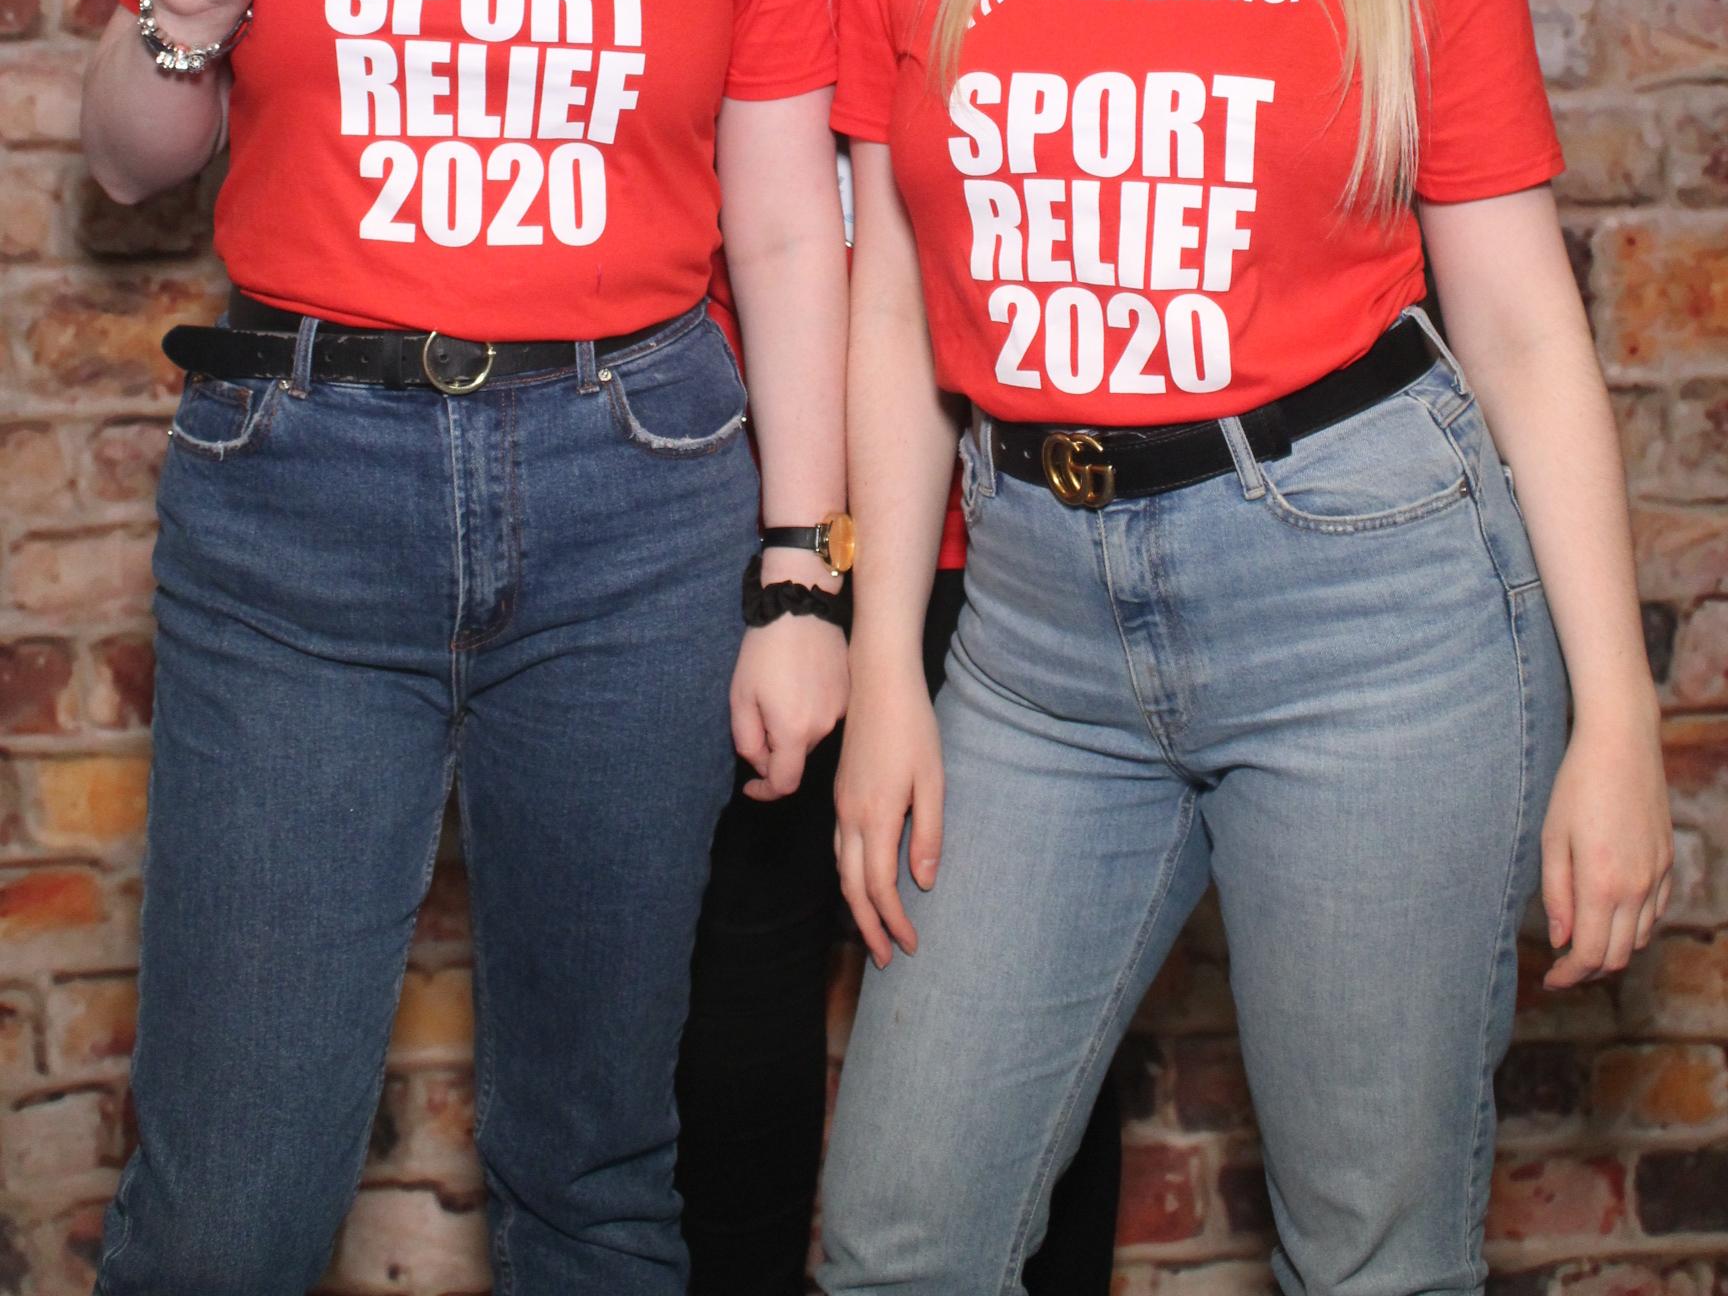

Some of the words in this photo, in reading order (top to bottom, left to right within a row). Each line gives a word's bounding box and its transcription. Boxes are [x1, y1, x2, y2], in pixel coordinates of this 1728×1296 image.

[335, 38, 646, 145] RELIEF
[948, 71, 1276, 184] SPORT
[359, 140, 607, 247] 2020
[963, 179, 1258, 292] RELIEF
[988, 284, 1232, 395] 2020
